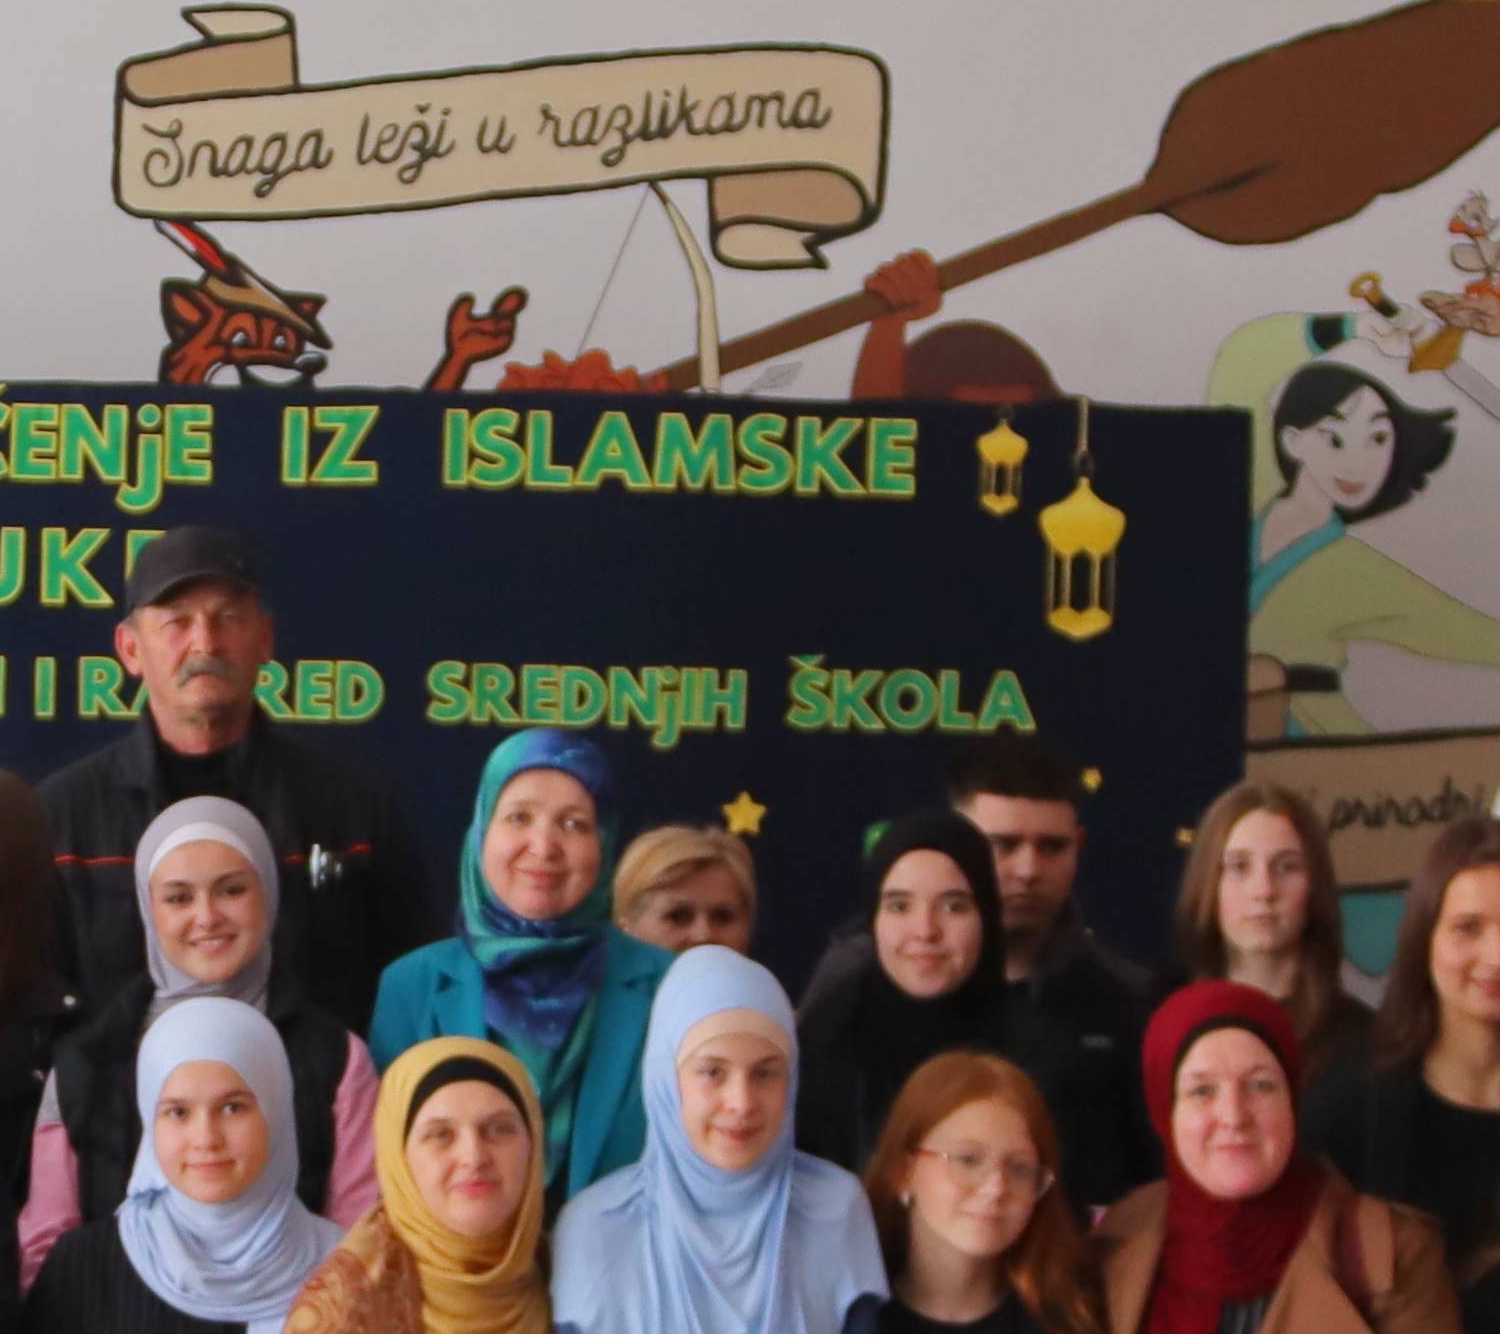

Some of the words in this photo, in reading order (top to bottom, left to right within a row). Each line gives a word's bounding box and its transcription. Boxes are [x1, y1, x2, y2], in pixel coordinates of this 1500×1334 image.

[141, 117, 333, 199] Snaga
[356, 101, 457, 184] leži
[476, 111, 517, 155] u
[538, 85, 833, 168] razlikama
[281, 404, 380, 487] IZ
[442, 407, 918, 499] ISLAMSKE
[33, 656, 58, 721] I
[786, 653, 1037, 734] ŠKOLA
